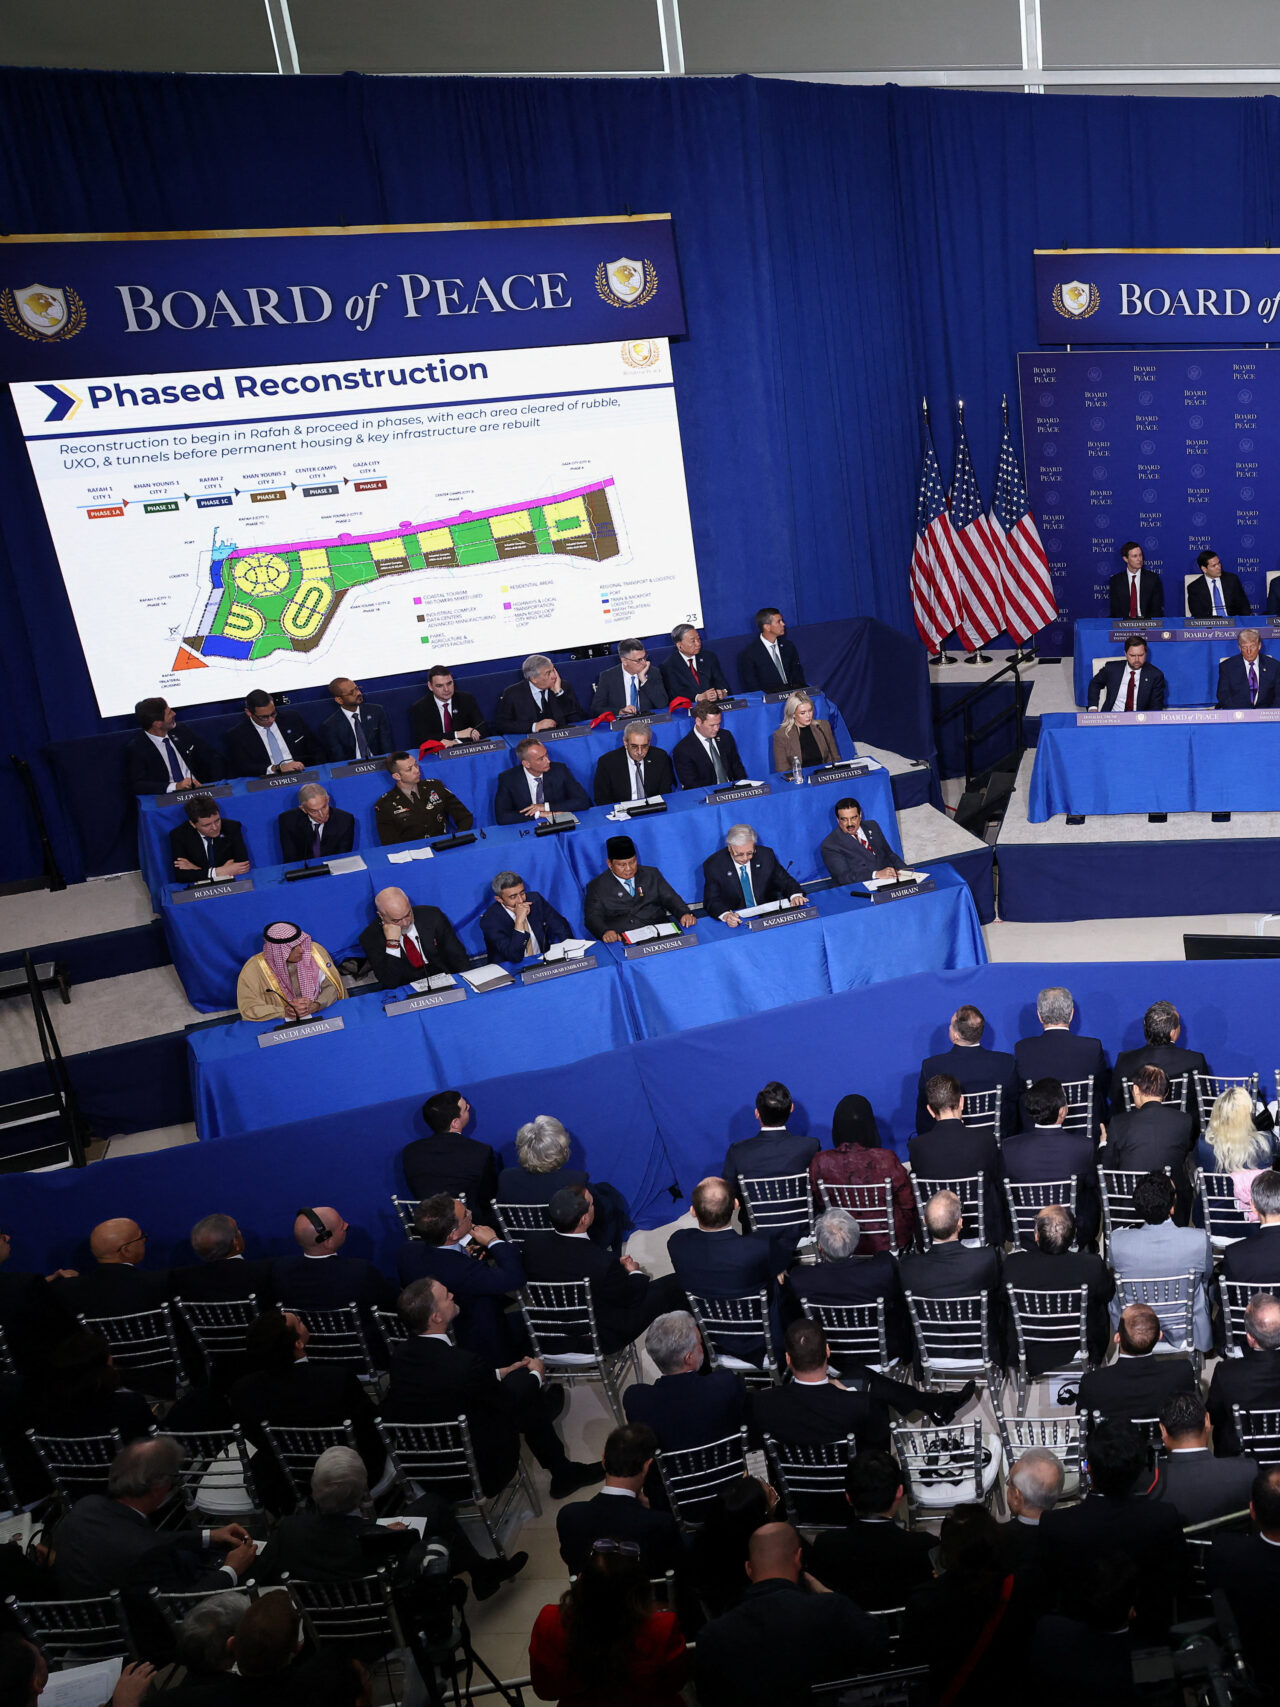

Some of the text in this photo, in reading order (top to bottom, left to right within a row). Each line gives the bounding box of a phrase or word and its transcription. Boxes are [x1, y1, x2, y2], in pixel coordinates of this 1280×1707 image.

[115, 273, 573, 333] BOARD of PEACE
[1118, 283, 1250, 316] BOARD
[87, 358, 488, 409] Phased Reconstruction
[59, 397, 620, 454] Reconstruction to begin in Rafah & proceed in phases, with each area cleared of rubble,
[63, 417, 540, 469] UXO, & tunnels before permanent housing & key infrastructure are rebuilt
[686, 614, 697, 622] 23
[355, 764, 376, 772] OMAN
[270, 778, 298, 786] CYPRUS
[818, 770, 862, 782] UNITED STATES
[716, 789, 762, 802] UNITED STATES
[195, 887, 232, 898] ROMANIA
[890, 886, 919, 898] BAHRAIN
[763, 911, 807, 927] KAZAKHSTAN
[643, 940, 682, 954] INDONESIA
[532, 971, 551, 979] UNITED
[409, 996, 444, 1008] ALBANIA
[273, 1023, 330, 1042] SAUDI ARABIA
